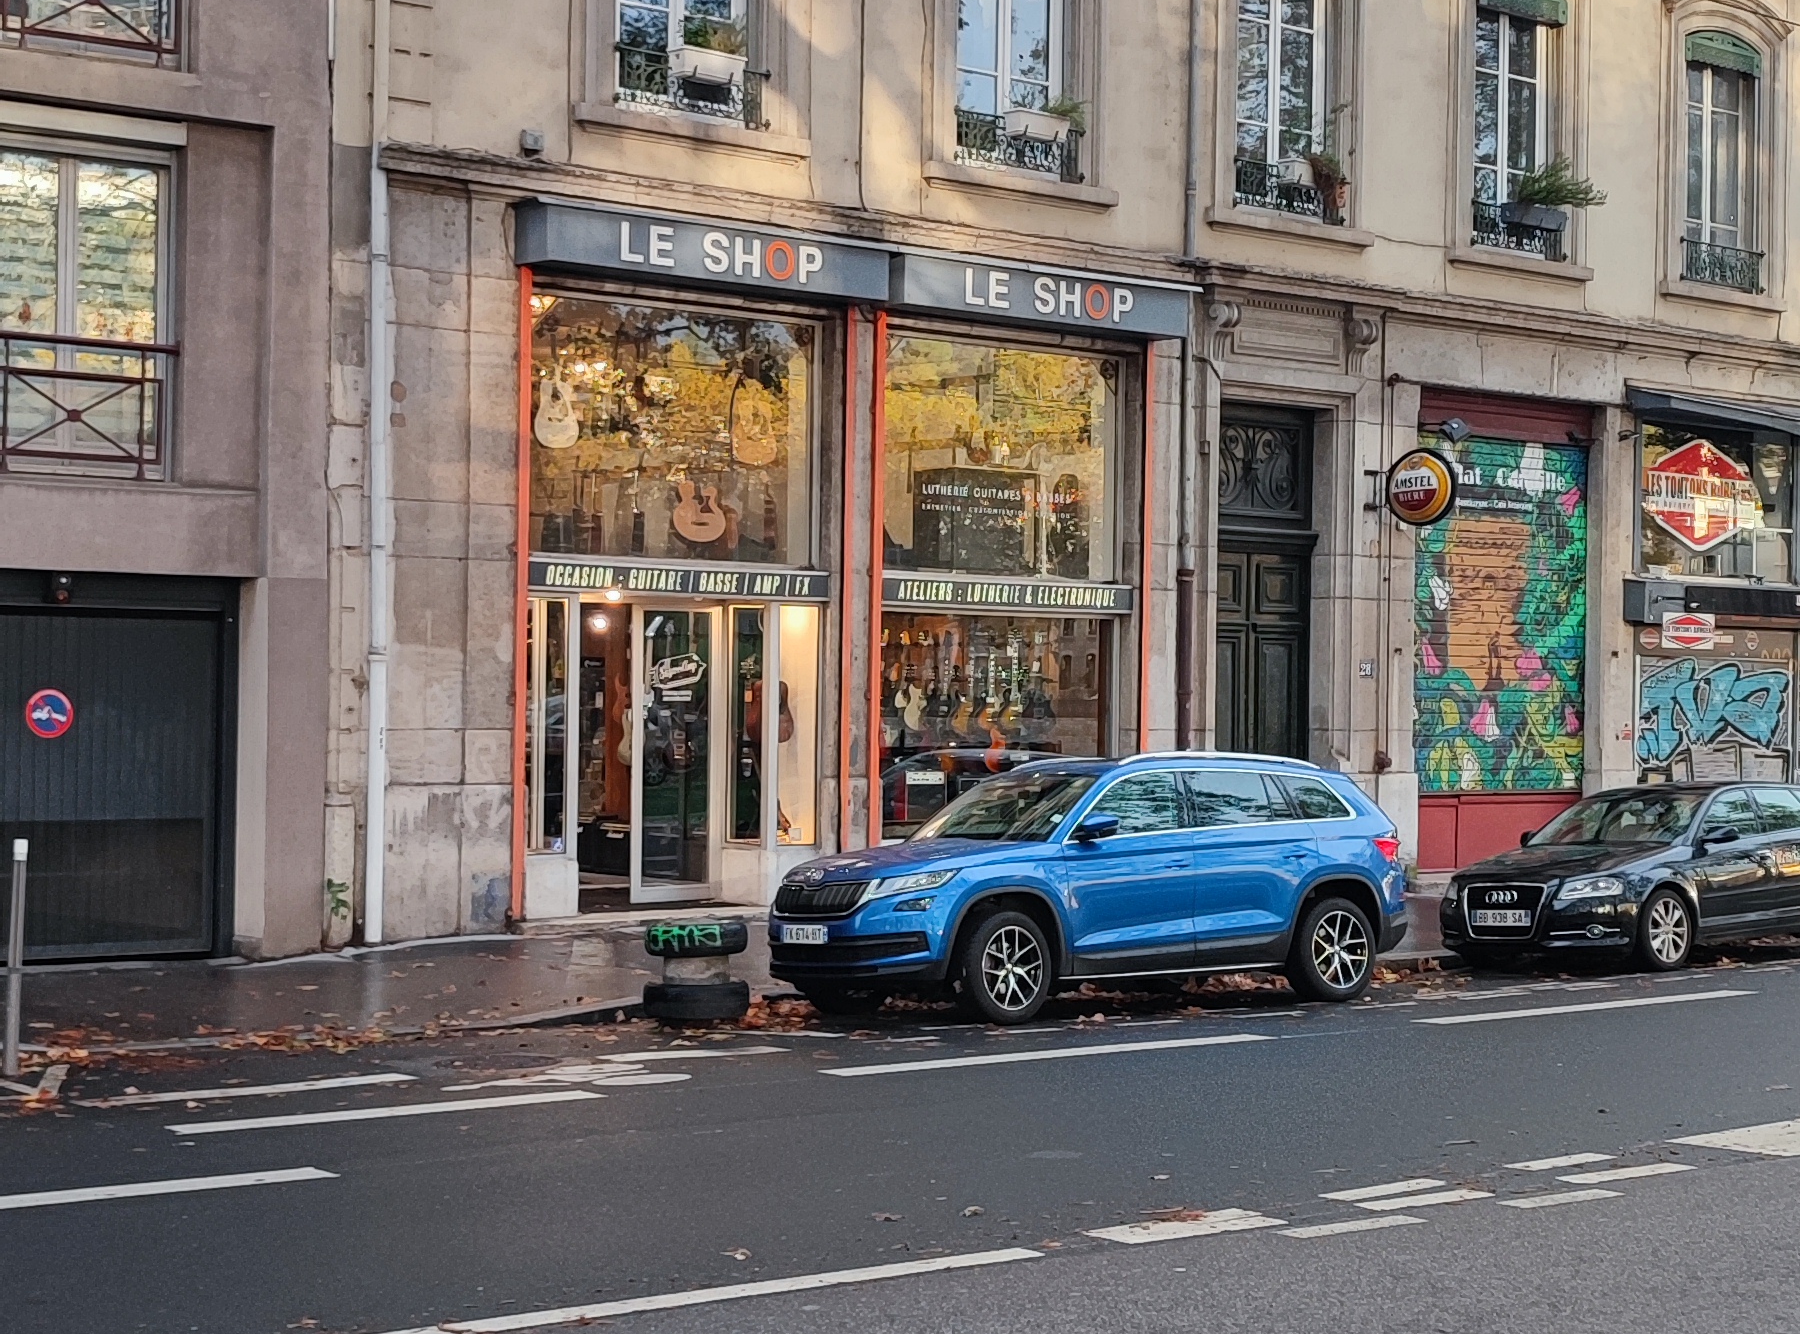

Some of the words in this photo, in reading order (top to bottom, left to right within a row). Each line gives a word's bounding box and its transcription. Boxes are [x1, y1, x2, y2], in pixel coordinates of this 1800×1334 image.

[620, 221, 675, 267] LE
[703, 231, 823, 284] SHOP
[965, 267, 1010, 309] LE
[1033, 276, 1134, 323] SHOP
[1394, 475, 1434, 490] AMSTEL
[545, 565, 614, 588] OCCASION
[628, 568, 685, 591] GUITARE
[698, 571, 739, 594] BASSE
[753, 575, 781, 595] AMP
[795, 575, 811, 595] FX
[898, 581, 953, 602] ATELIERS
[967, 583, 1020, 604] LUTHERIE
[1037, 586, 1117, 609] ELECTRONIQUE
[1359, 663, 1371, 676] 28
